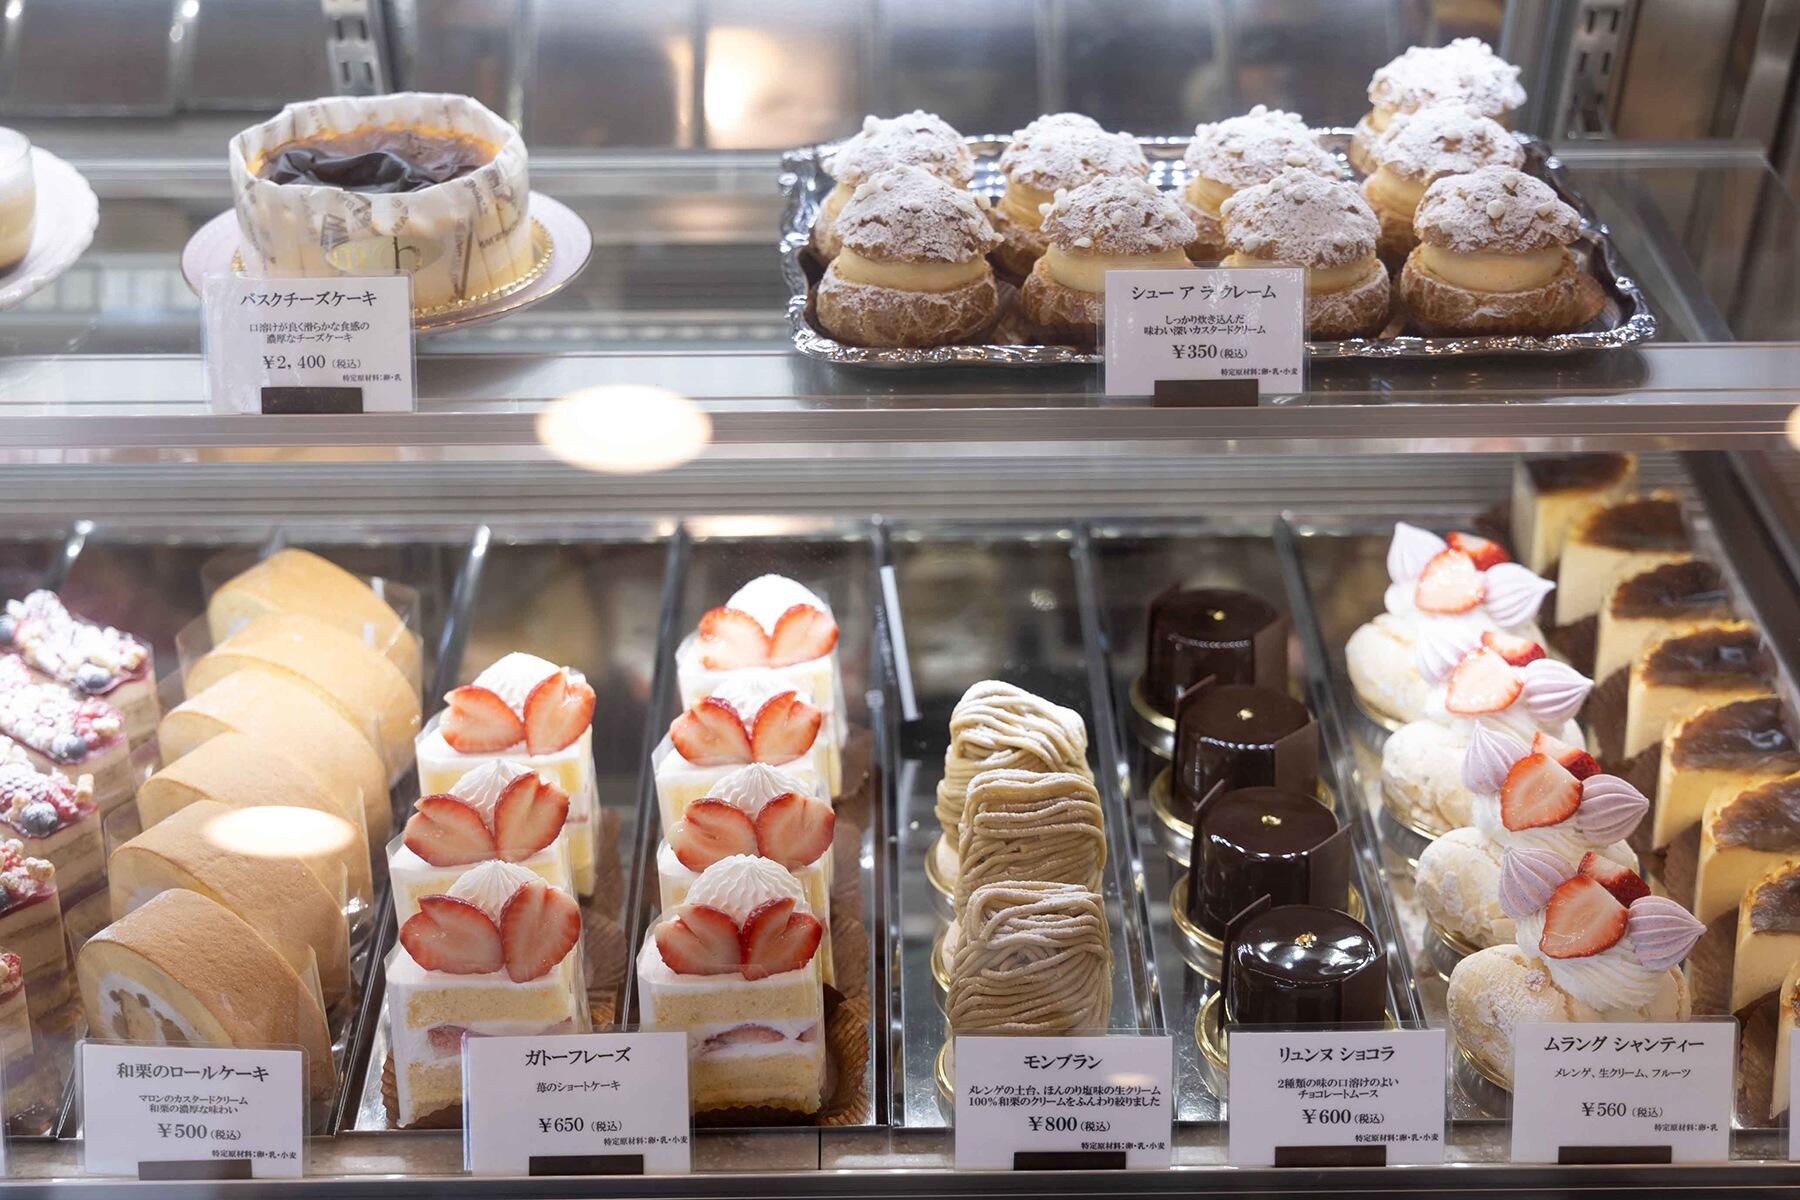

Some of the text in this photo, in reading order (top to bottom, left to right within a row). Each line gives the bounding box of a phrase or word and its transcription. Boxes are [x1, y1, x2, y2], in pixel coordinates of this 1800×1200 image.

[1131, 285, 1276, 300] シュー ア ラ クレーム
[240, 291, 377, 308] バスクチーズケーキ
[1165, 315, 1245, 325] しっかり炊き込んだ
[249, 321, 370, 332] 口溶けが良く滑らかな食感の
[1144, 326, 1266, 335] 味わい深いカスタードクリーム
[267, 333, 353, 344] 濃厚なチーズケーキ
[1544, 1036, 1704, 1053] ムラング シャンティー
[525, 1047, 631, 1066] ガトーフレーズ
[1279, 1046, 1395, 1063] リュンヌ ショコラ
[1024, 1054, 1103, 1070] モンブラン
[117, 1063, 269, 1082] 和栗のロールケーキ
[537, 1080, 620, 1093] 苺のショートケーキ
[1277, 1077, 1399, 1089] 2種類の味の口溶けのよい
[968, 1085, 1161, 1096] メレンゲの土台、ほんのり塩味の生クリーム
[1298, 1089, 1379, 1099] チョコレートムース
[139, 1095, 248, 1105] マロンのカスタードクリーム
[150, 1104, 239, 1114] 和栗の濃厚な味わい
